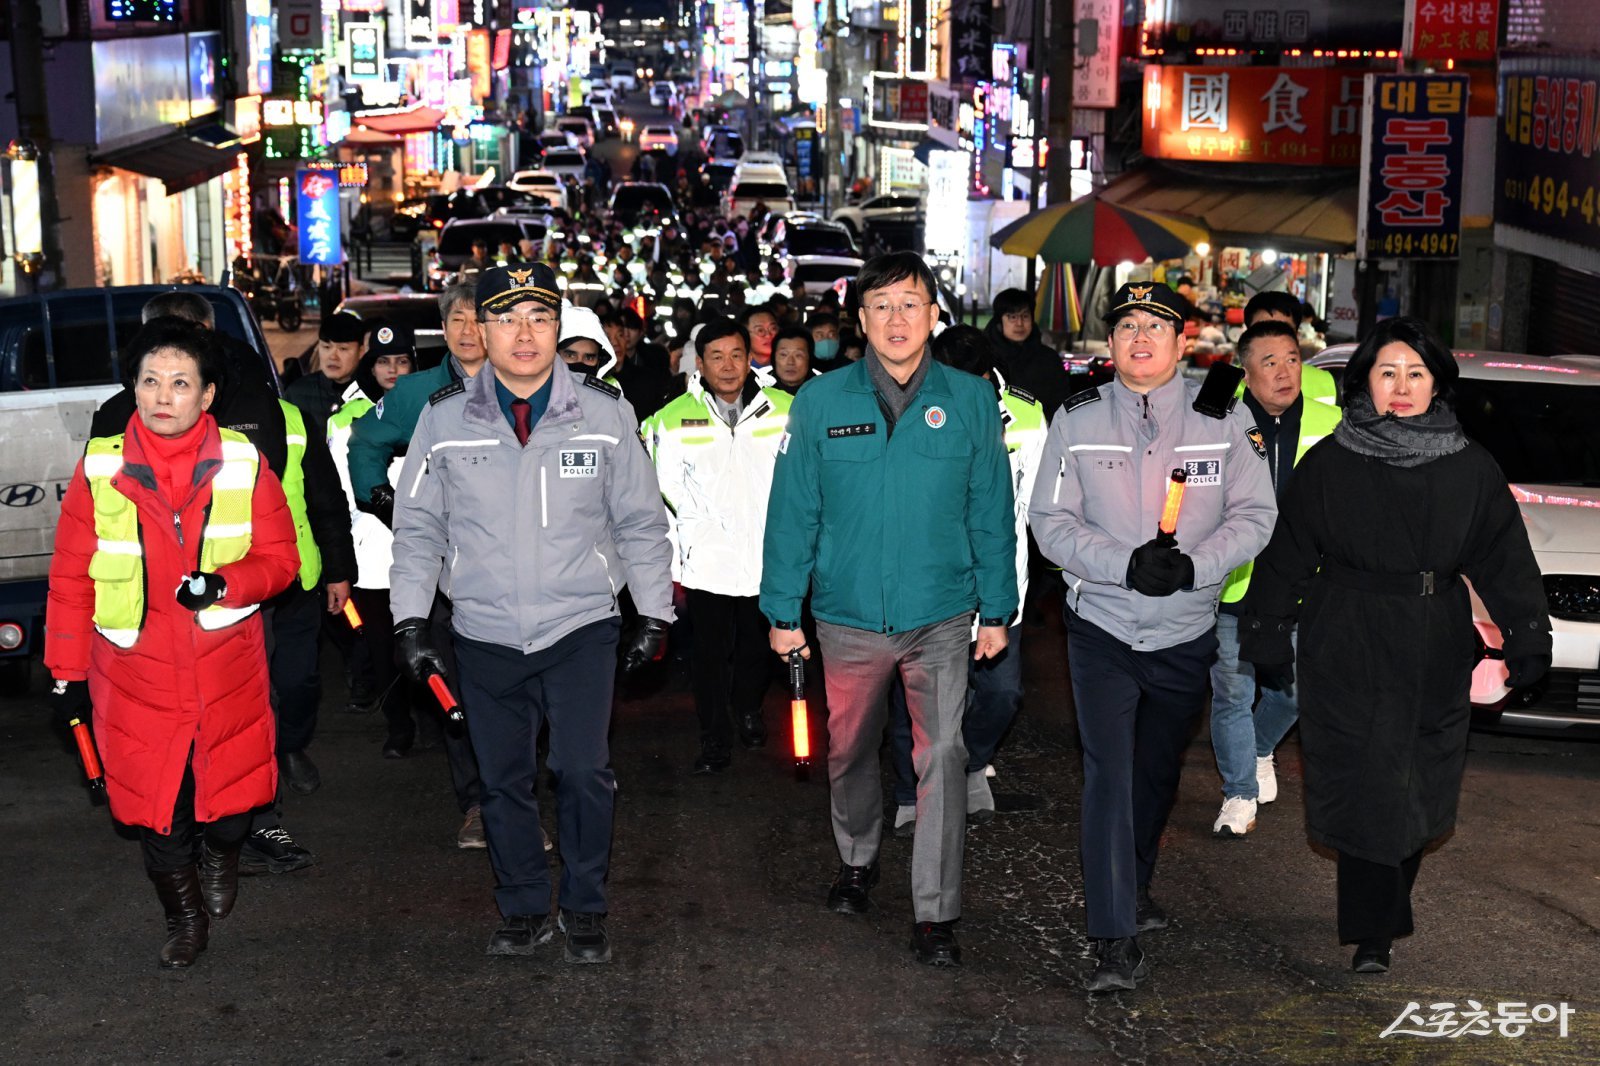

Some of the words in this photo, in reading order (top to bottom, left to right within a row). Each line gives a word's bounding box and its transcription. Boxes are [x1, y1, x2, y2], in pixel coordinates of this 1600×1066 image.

[1419, 1, 1494, 24] 수선전문
[1419, 30, 1489, 50] 加工衣服
[1380, 81, 1462, 113] 대림
[1375, 118, 1451, 226] 부동산
[1528, 174, 1600, 227] 494-4
[1187, 476, 1218, 484] POLICE
